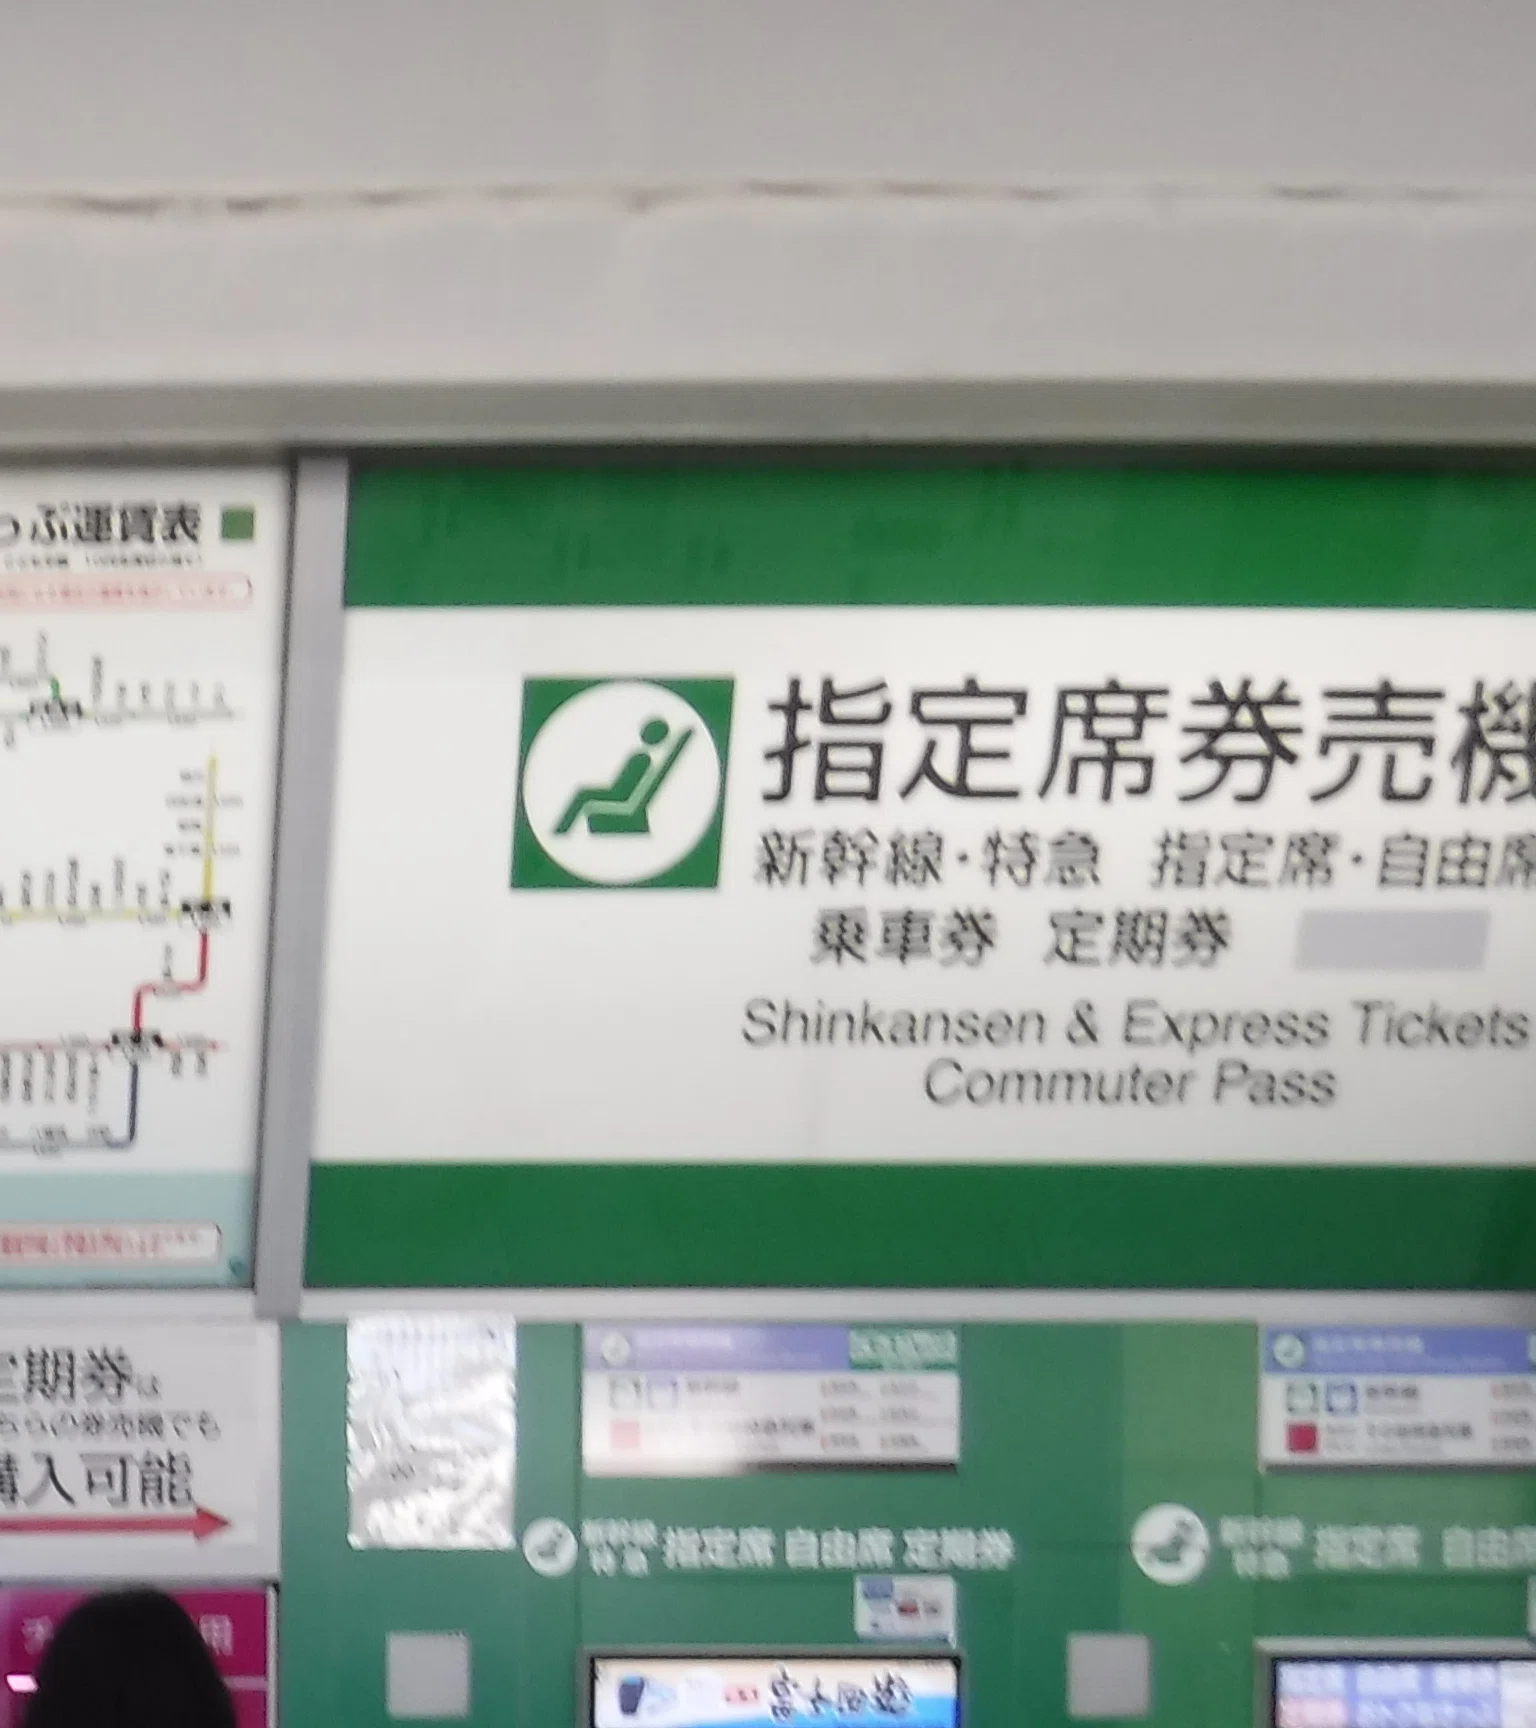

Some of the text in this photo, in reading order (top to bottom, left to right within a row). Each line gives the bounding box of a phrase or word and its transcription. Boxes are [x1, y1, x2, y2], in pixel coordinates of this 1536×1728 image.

[761, 677, 1536, 804] 指定席券売機
[810, 907, 1232, 969] 乗車券 定期券
[742, 1000, 1530, 1058] Shinkansen & Express Tickets
[924, 1060, 1338, 1109] Commuter Pass
